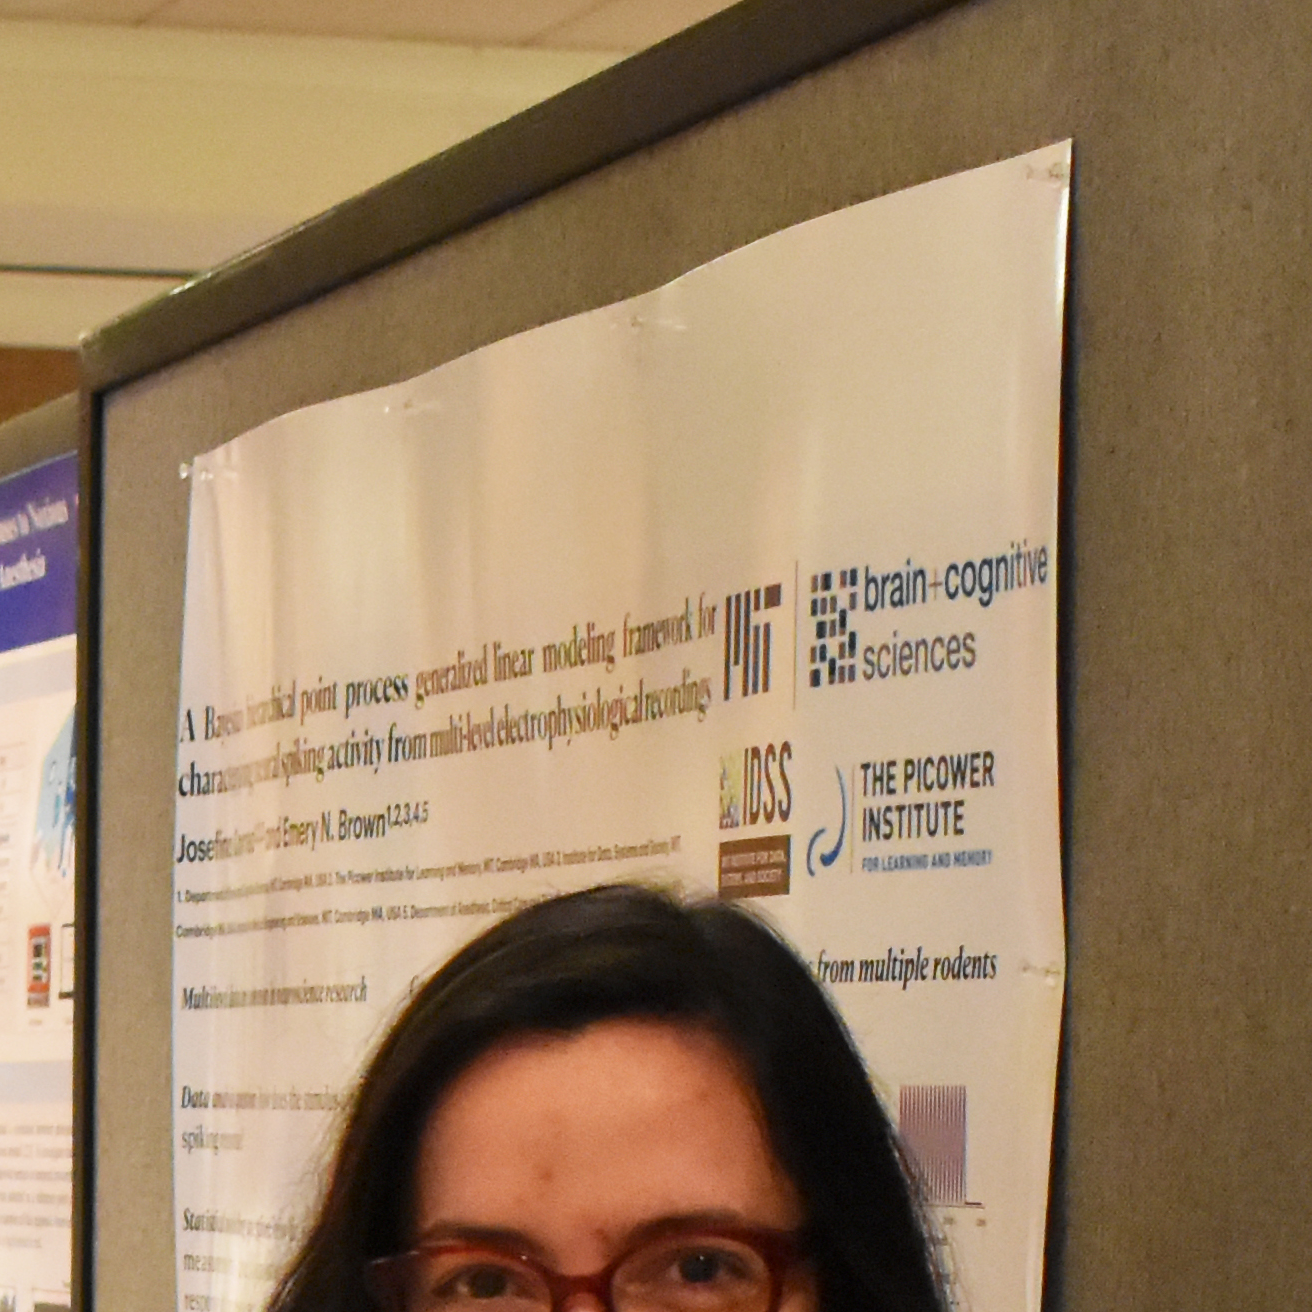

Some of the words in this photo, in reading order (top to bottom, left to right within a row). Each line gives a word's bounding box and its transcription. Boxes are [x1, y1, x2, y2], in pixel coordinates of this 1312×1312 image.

[864, 538, 1048, 612] brain+cognitive
[180, 708, 196, 742] A
[301, 676, 337, 726] point
[345, 673, 409, 719] process
[416, 643, 488, 709] generalized
[493, 641, 535, 682] linear
[543, 622, 616, 673] modeling
[624, 612, 693, 657] framework
[698, 592, 717, 639] for
[862, 630, 976, 681] sciences
[327, 729, 384, 775] activity
[387, 722, 427, 763] from
[429, 706, 495, 758] multi-level
[497, 678, 643, 750] electrophysiological
[645, 666, 711, 722] recordings
[742, 740, 792, 827] IDSS
[860, 759, 897, 797] THE
[903, 750, 996, 795] PICOWER
[283, 815, 319, 851] Emery
[320, 811, 335, 843] N.
[862, 799, 966, 843] INSTITUTE
[931, 852, 951, 869] AND
[816, 949, 855, 987] from
[857, 946, 929, 991] multiple
[932, 945, 997, 981] rodents
